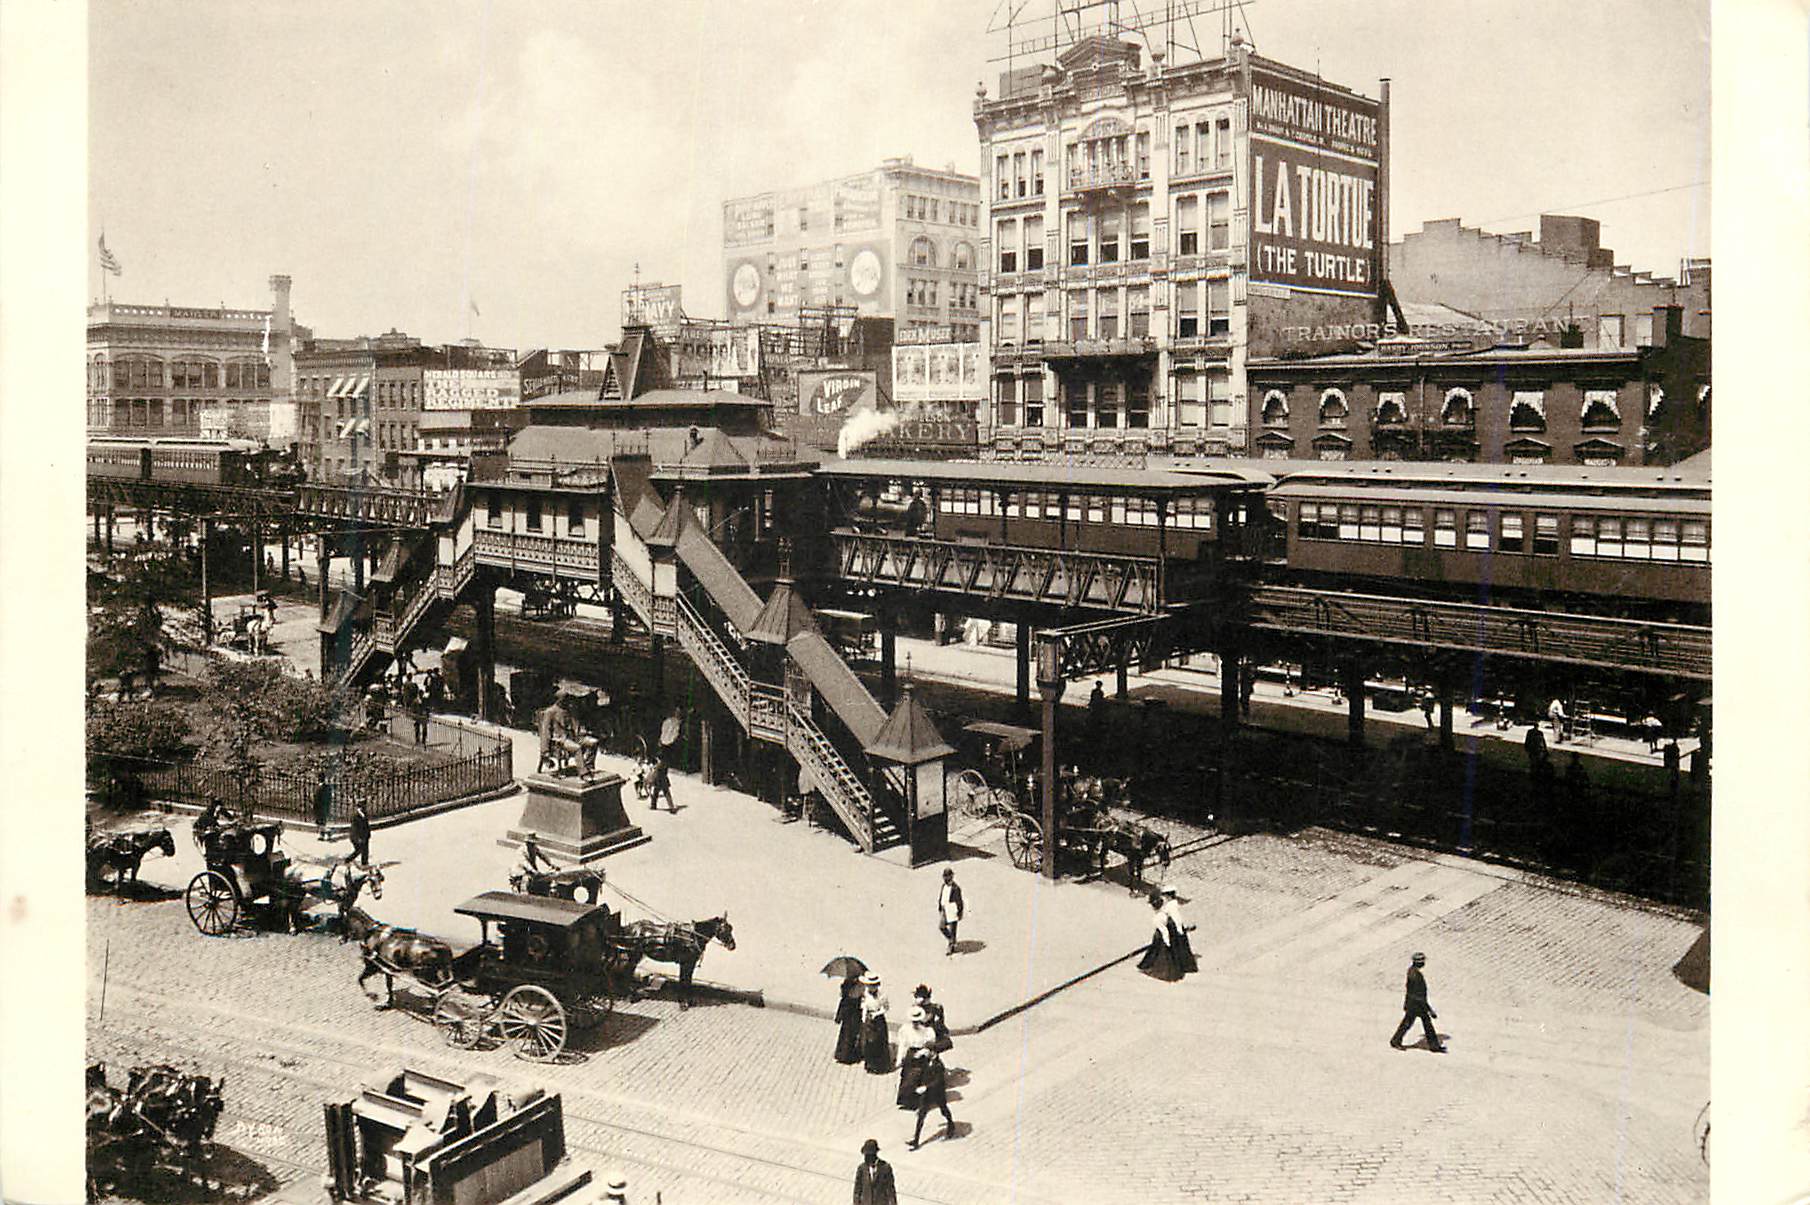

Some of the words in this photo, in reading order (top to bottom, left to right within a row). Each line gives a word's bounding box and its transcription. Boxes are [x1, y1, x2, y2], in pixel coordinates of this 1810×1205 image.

[1252, 84, 1322, 132] MANHATTAN
[1325, 105, 1377, 146] THEATRE
[1254, 155, 1293, 238] LA
[1296, 165, 1374, 249] TORTUE
[1257, 242, 1297, 275] (THE
[1304, 251, 1371, 285] TURTLE)
[816, 395, 843, 413] LEAF
